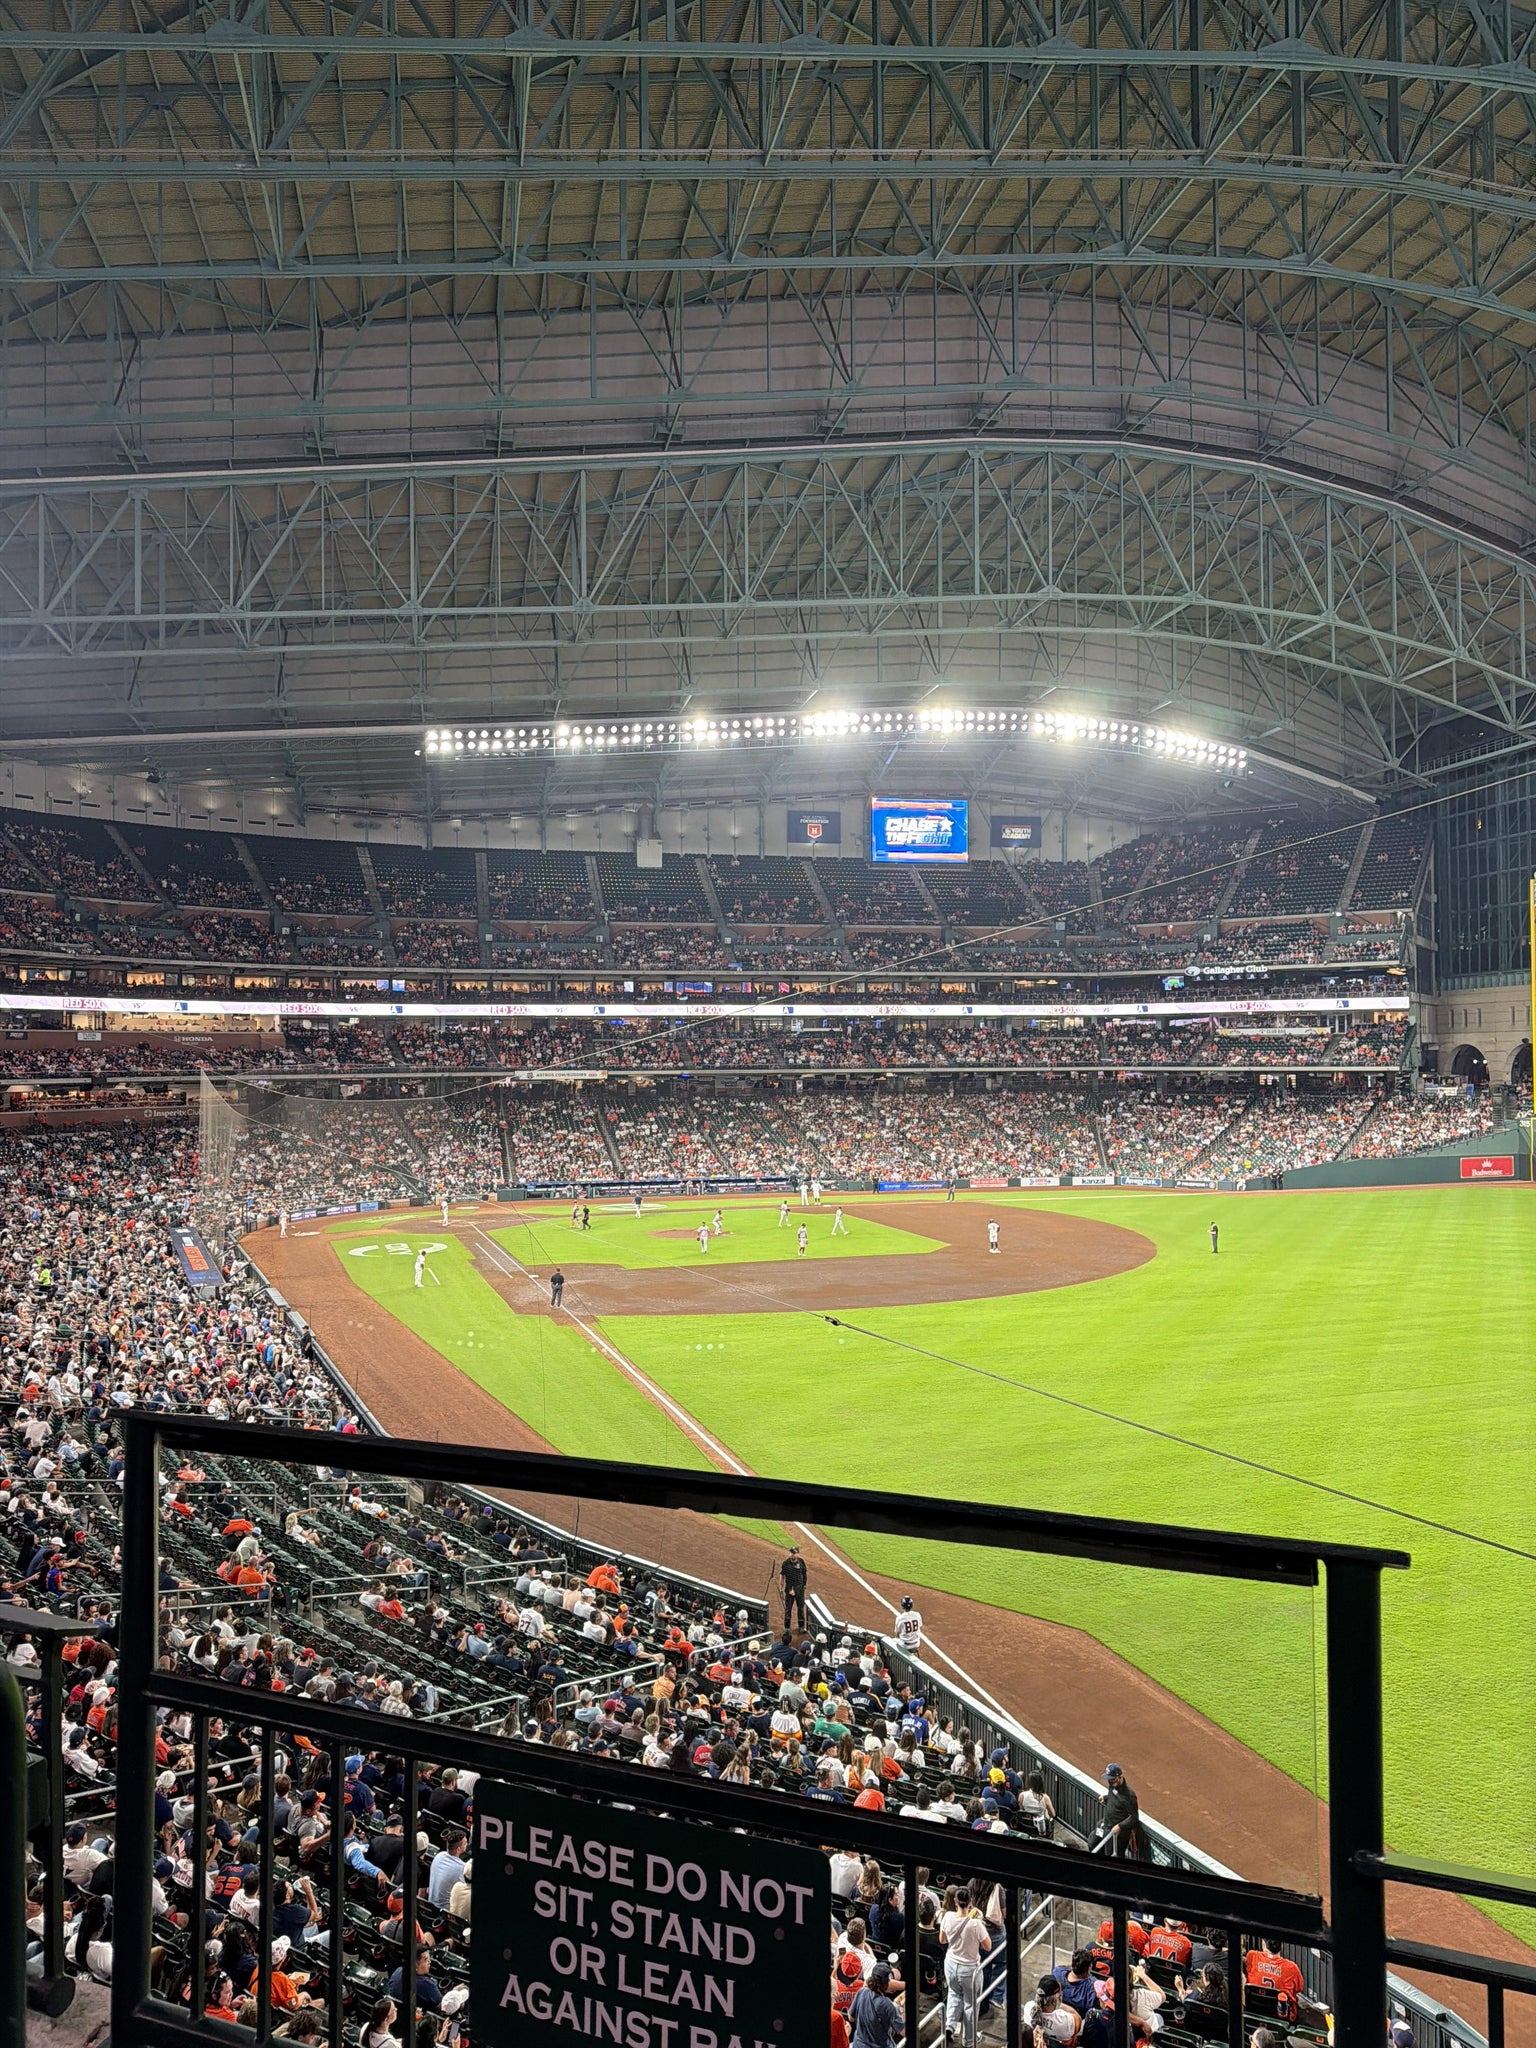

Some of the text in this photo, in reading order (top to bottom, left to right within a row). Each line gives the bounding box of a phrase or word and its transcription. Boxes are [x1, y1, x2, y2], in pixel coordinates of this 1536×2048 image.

[885, 818, 938, 832] CHASE
[1203, 964, 1268, 976] Gallagher Club
[63, 999, 82, 1009] RED
[83, 999, 103, 1009] SOX
[281, 1004, 298, 1013] RED
[299, 1004, 320, 1013] SOX
[153, 1110, 187, 1118] Insperity
[1471, 1168, 1503, 1176] Budweiser
[904, 1619, 918, 1634] BB
[479, 1814, 634, 1888] PLEASE
[645, 1853, 813, 1925] DO NOT
[533, 1879, 756, 1966] SIT, STAND
[1151, 1933, 1184, 1950] ALVAREZ
[549, 1937, 736, 2018] OR LEAN
[499, 1973, 679, 2048] AGAINST
